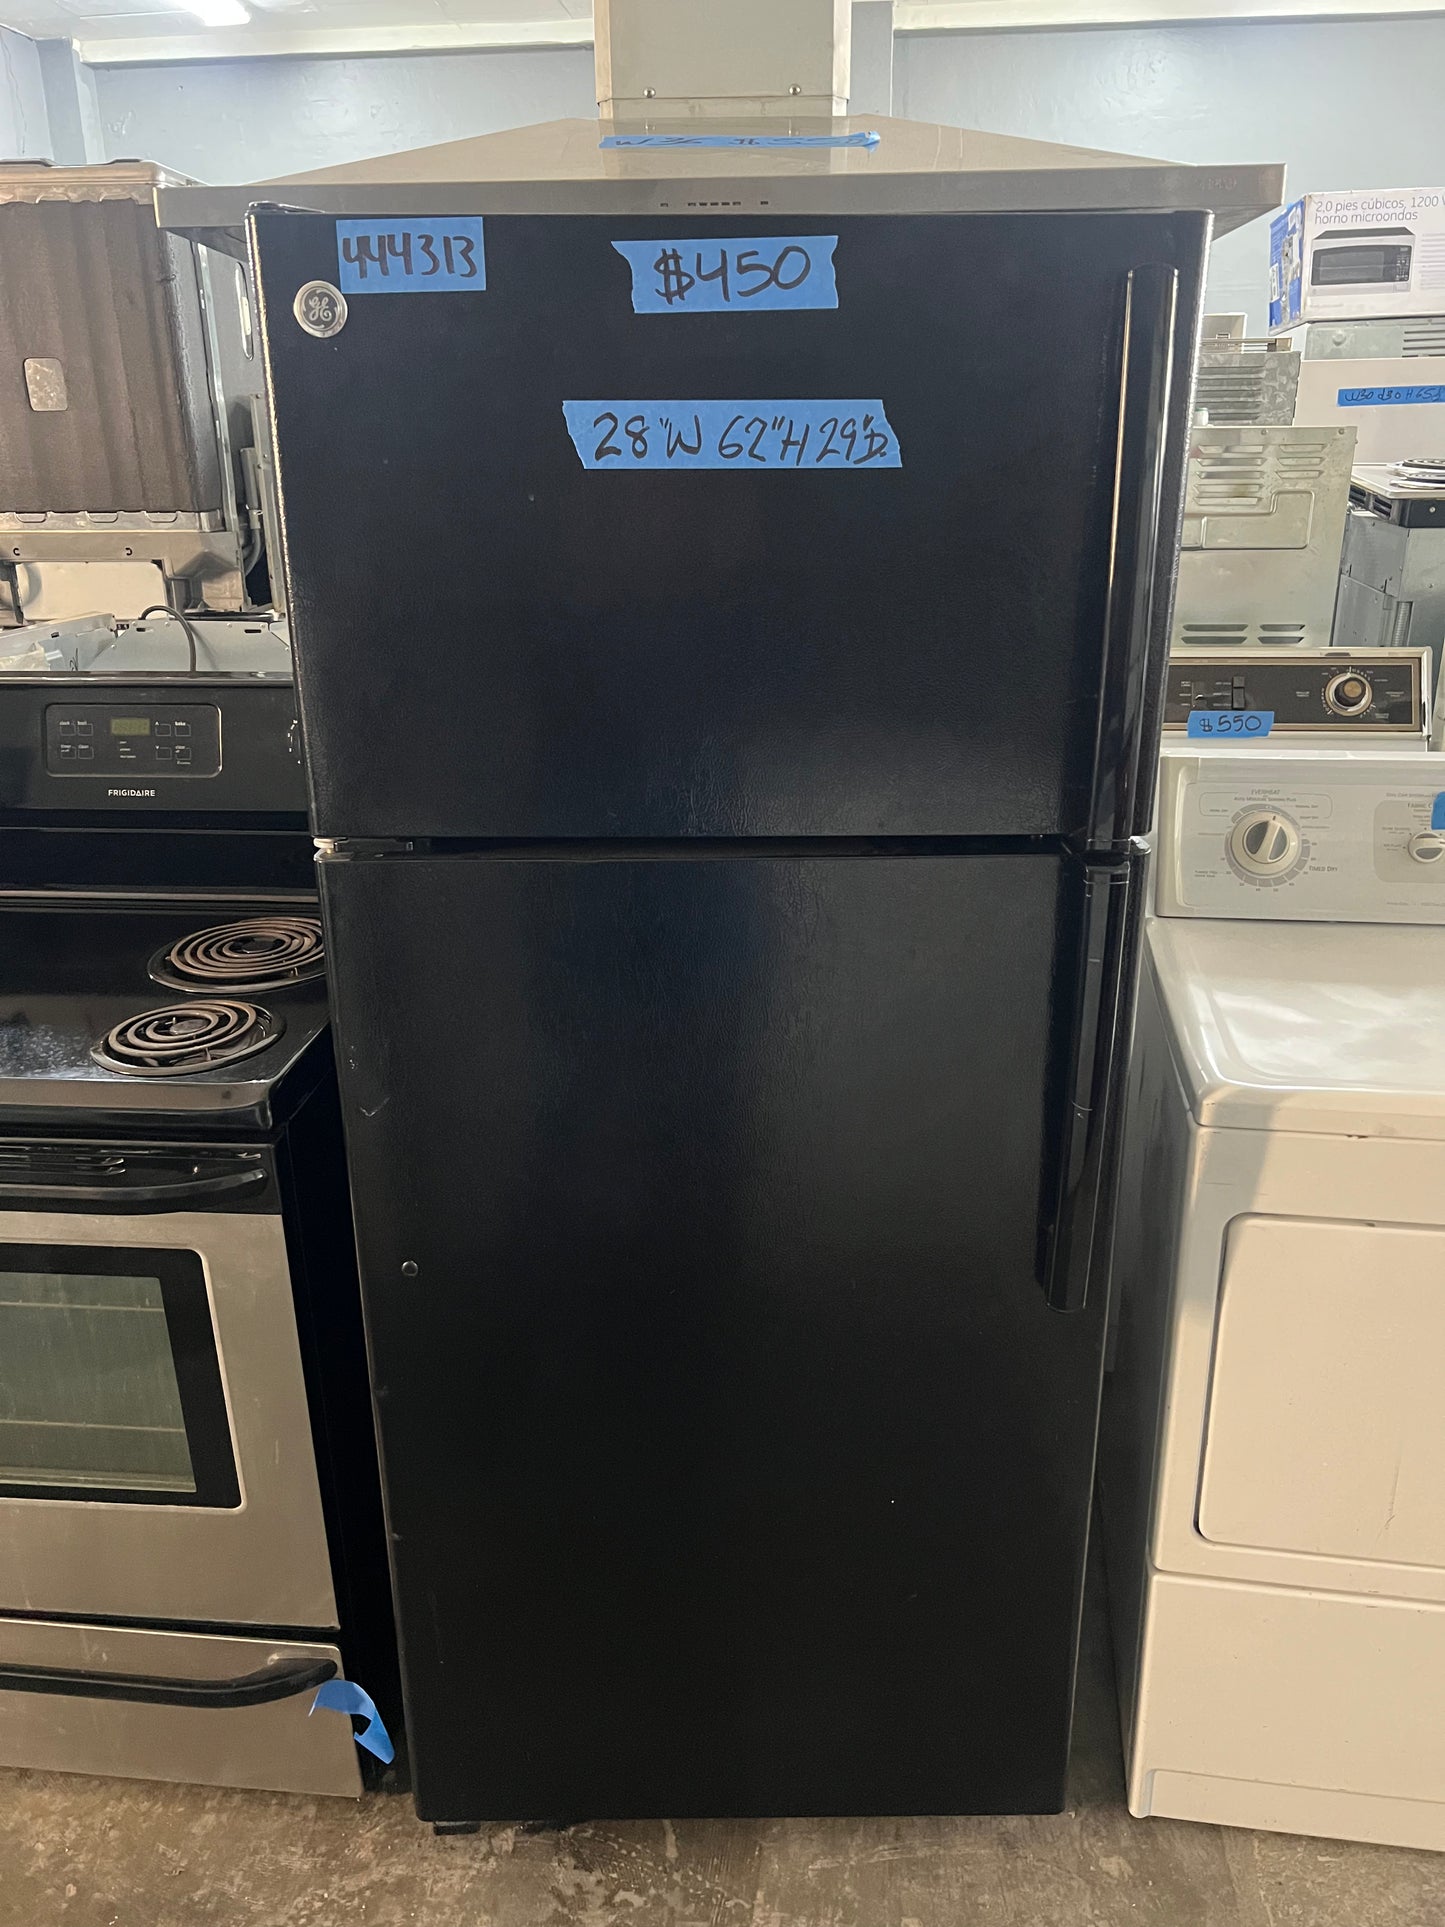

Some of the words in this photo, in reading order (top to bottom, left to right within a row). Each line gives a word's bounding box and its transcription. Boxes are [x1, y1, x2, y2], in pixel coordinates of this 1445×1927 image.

[1335, 199, 1358, 214] pies
[1360, 197, 1406, 211] cúbicos,
[1410, 195, 1439, 208] 1200
[1314, 213, 1349, 225] horno
[1350, 208, 1418, 223] microondas
[341, 232, 478, 280] 444313
[652, 245, 812, 305] $450
[1199, 714, 1262, 733] $550
[107, 789, 156, 797] FRIGIDAIRE
